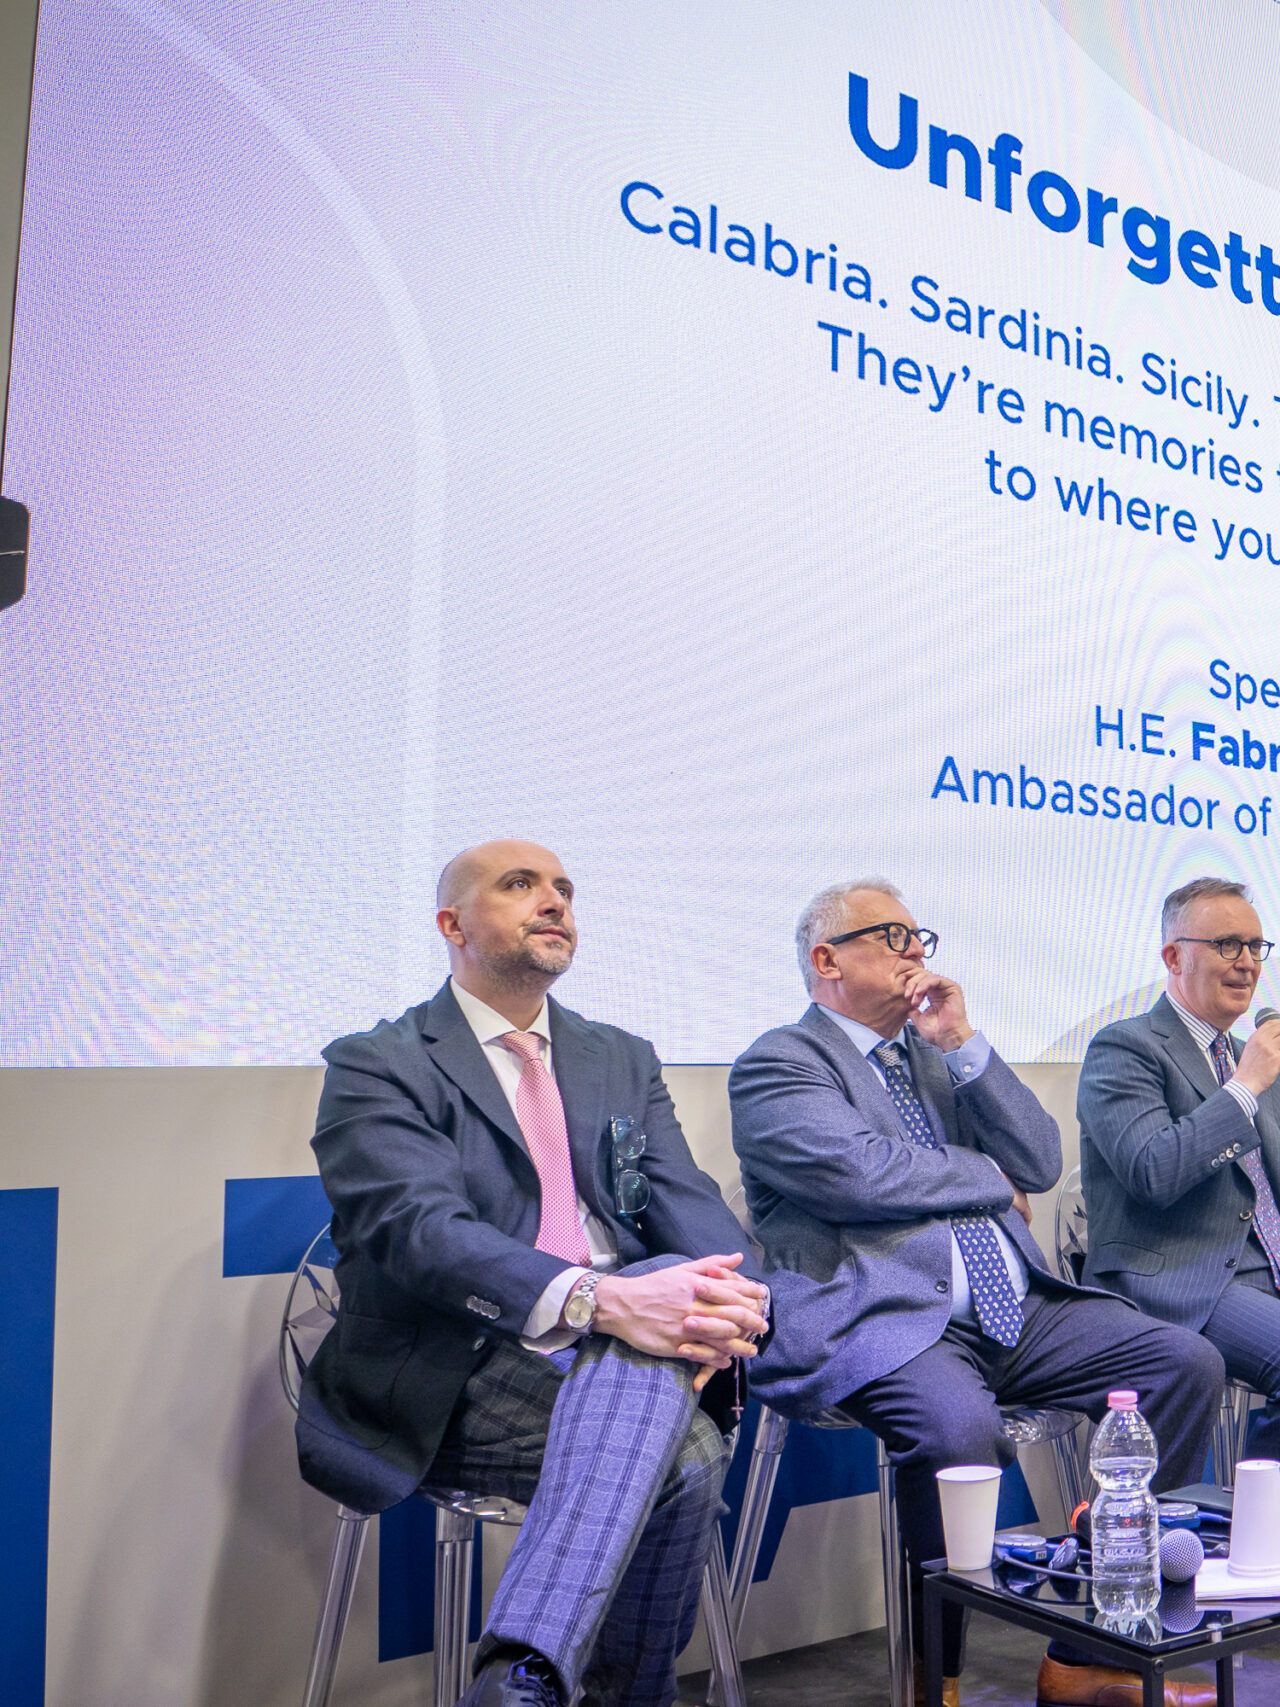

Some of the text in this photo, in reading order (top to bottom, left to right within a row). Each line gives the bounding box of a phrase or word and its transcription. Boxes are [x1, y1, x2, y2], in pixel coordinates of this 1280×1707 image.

[619, 180, 888, 309] Calabria.
[909, 275, 1124, 384] Sardinia.
[1141, 352, 1260, 430] Sicily.
[817, 320, 1025, 424] They’re
[1044, 399, 1263, 494] memories
[984, 449, 1037, 502] to
[1053, 475, 1198, 543] where
[1095, 704, 1176, 758] H.E.
[930, 755, 1220, 830] Ambassador
[1233, 796, 1272, 837] of
